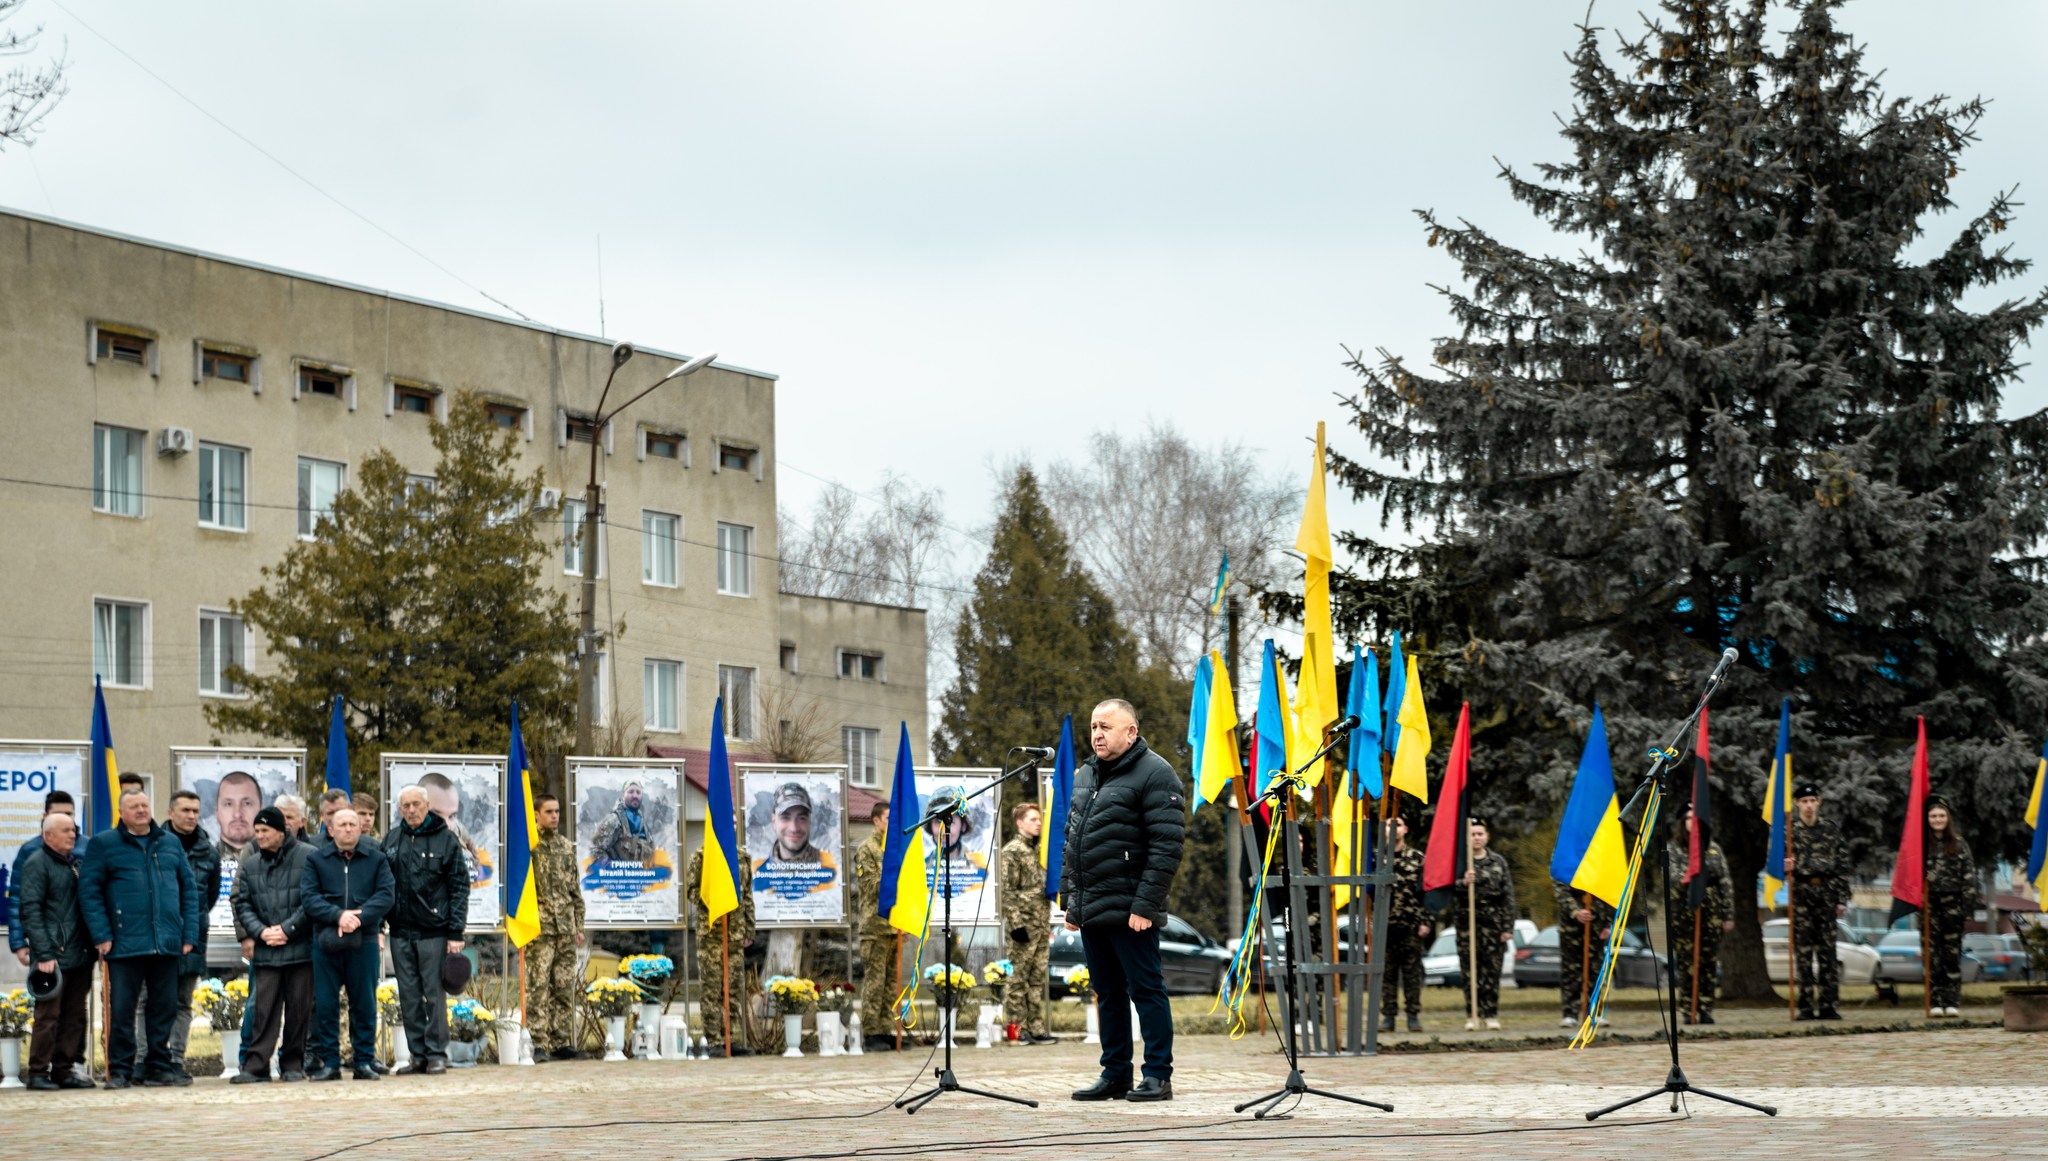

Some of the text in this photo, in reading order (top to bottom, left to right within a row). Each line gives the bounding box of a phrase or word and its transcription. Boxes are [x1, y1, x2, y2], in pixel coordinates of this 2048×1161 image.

[611, 860, 644, 869] ГРИНЧУК
[599, 868, 656, 877] Віталій Іванович
[756, 870, 833, 879] Володимир Андрійович
